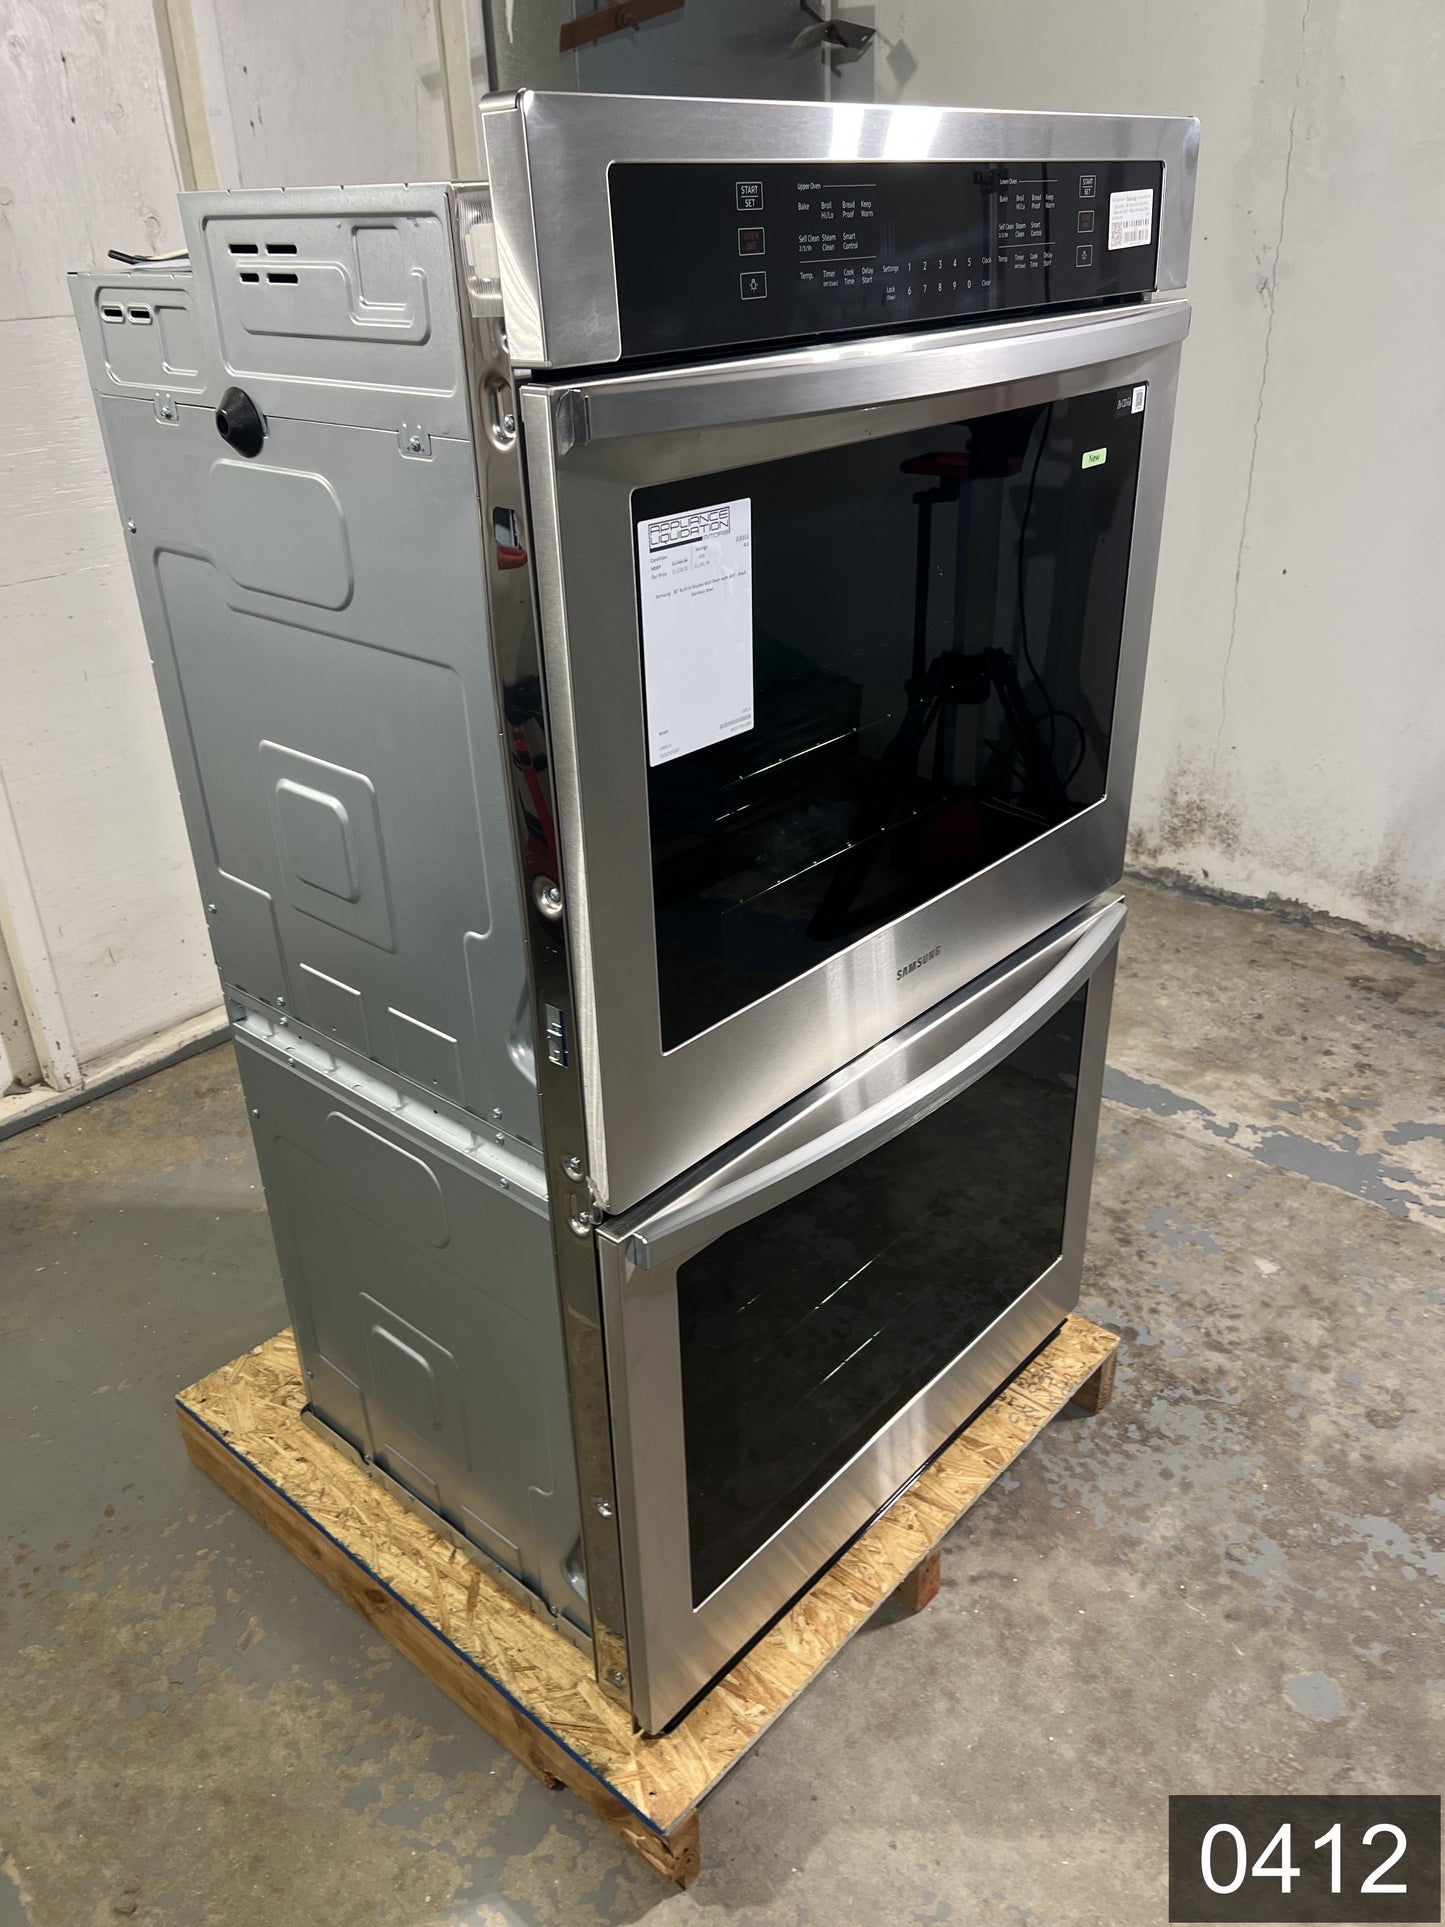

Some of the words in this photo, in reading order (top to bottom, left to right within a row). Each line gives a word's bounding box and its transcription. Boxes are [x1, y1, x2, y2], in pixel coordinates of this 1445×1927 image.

[741, 185, 758, 195] START
[810, 182, 821, 190] Oven
[744, 199, 755, 208] SET
[798, 202, 810, 211] Bake
[842, 200, 855, 209] Bread
[861, 200, 872, 209] Keep
[808, 234, 820, 243] Clean
[822, 233, 837, 242] Steam
[843, 232, 856, 241] Smart
[822, 243, 835, 251] Clean
[843, 241, 859, 250] Control
[907, 262, 911, 271] 1
[923, 261, 927, 271] 2
[938, 259, 943, 269] 3
[953, 259, 957, 267] 4
[967, 257, 972, 267] 5
[843, 268, 855, 276] Cook
[862, 267, 874, 275] Delay
[882, 265, 900, 273] Settings
[823, 270, 836, 278] Timer
[862, 276, 873, 284] Start
[967, 280, 971, 289] 0
[923, 284, 927, 293] 7
[938, 282, 942, 292] 8
[953, 281, 957, 290] 9
[907, 286, 912, 295] 6
[1089, 454, 1100, 463] New
[650, 508, 728, 536] APPLIANCE
[651, 520, 728, 546] LIQUIDATION
[896, 945, 941, 981] SAMSUNG
